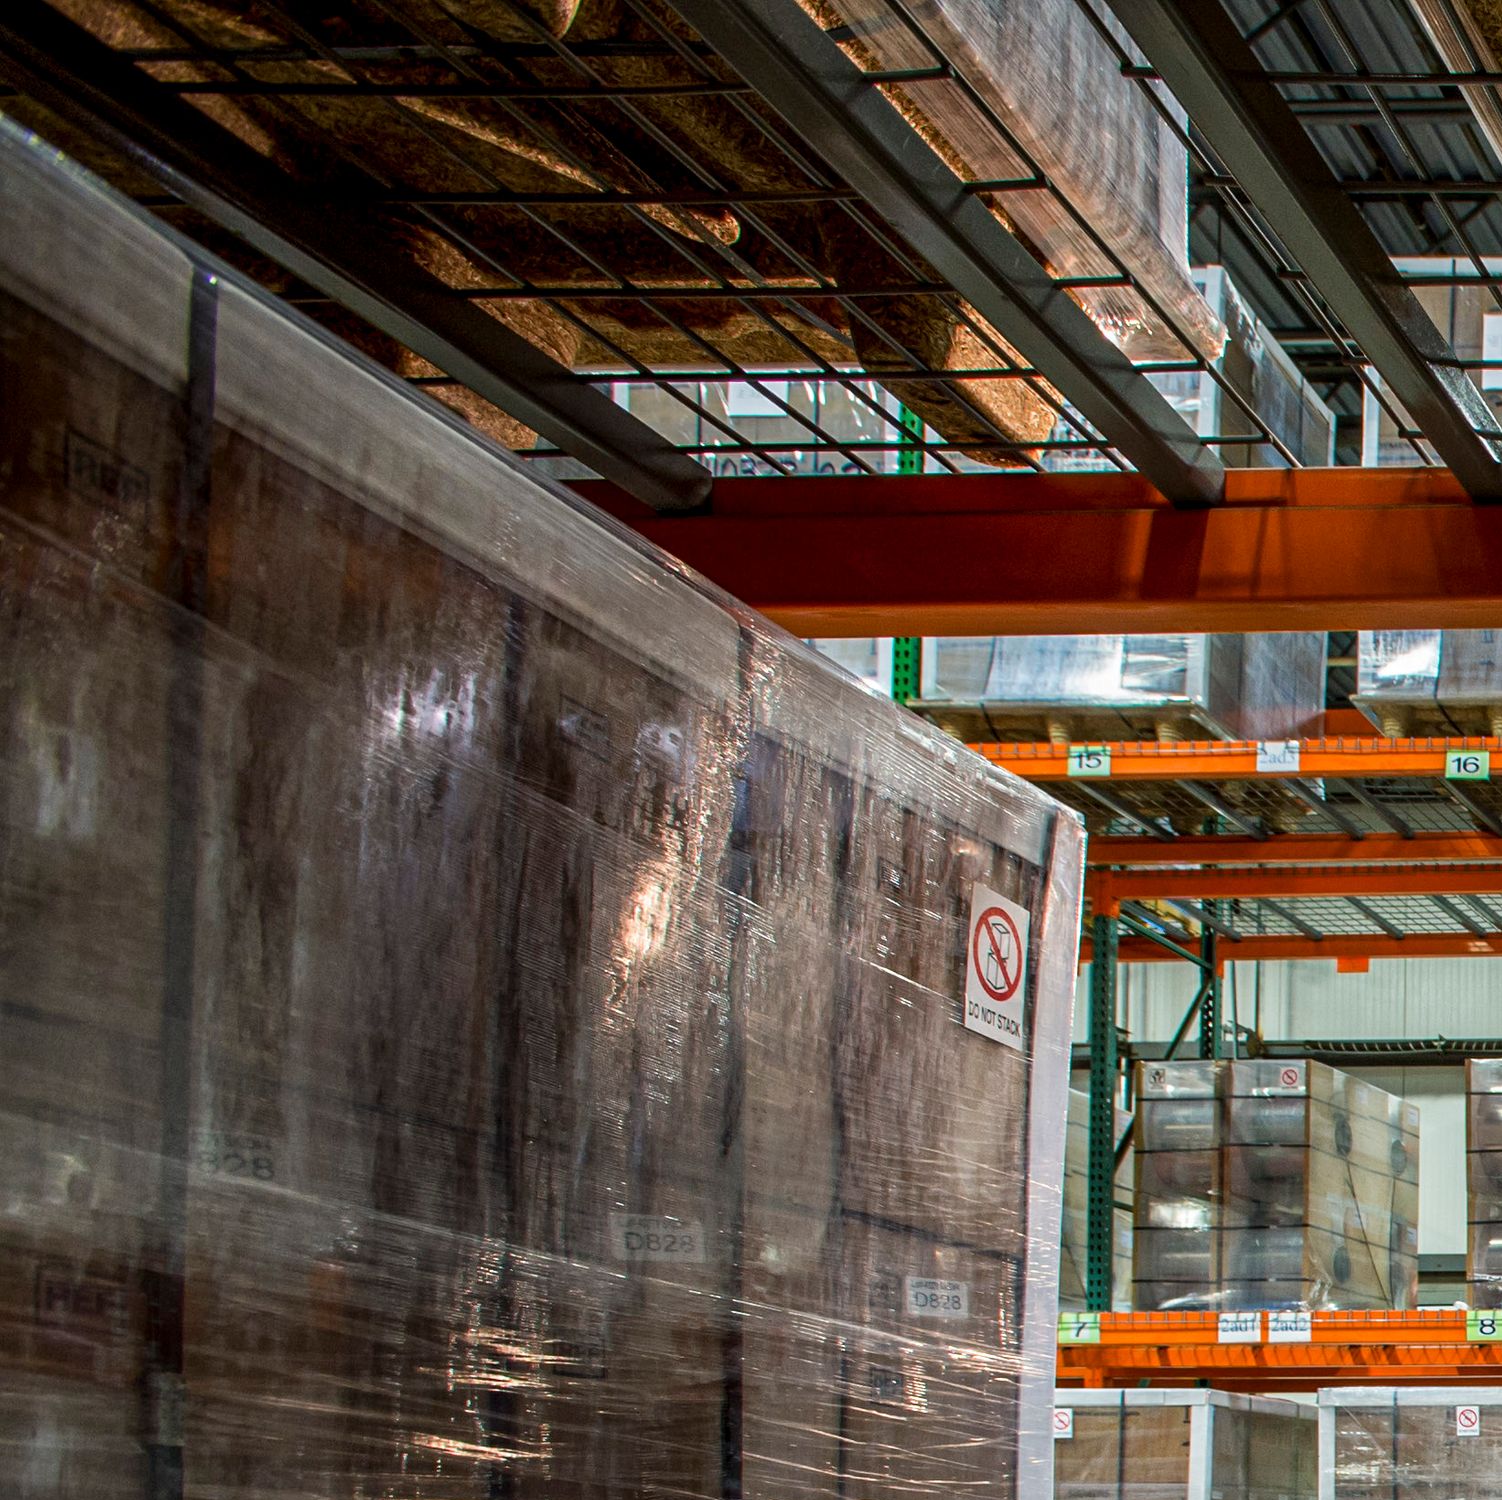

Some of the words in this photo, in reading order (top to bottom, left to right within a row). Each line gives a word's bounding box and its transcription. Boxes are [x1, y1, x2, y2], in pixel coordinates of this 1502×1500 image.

[1074, 753, 1102, 770] 15
[1451, 756, 1480, 774] 16
[997, 1013, 1021, 1038] STACK
[624, 1231, 694, 1253] D828
[915, 1291, 961, 1311] D828
[1479, 1318, 1497, 1335] 8
